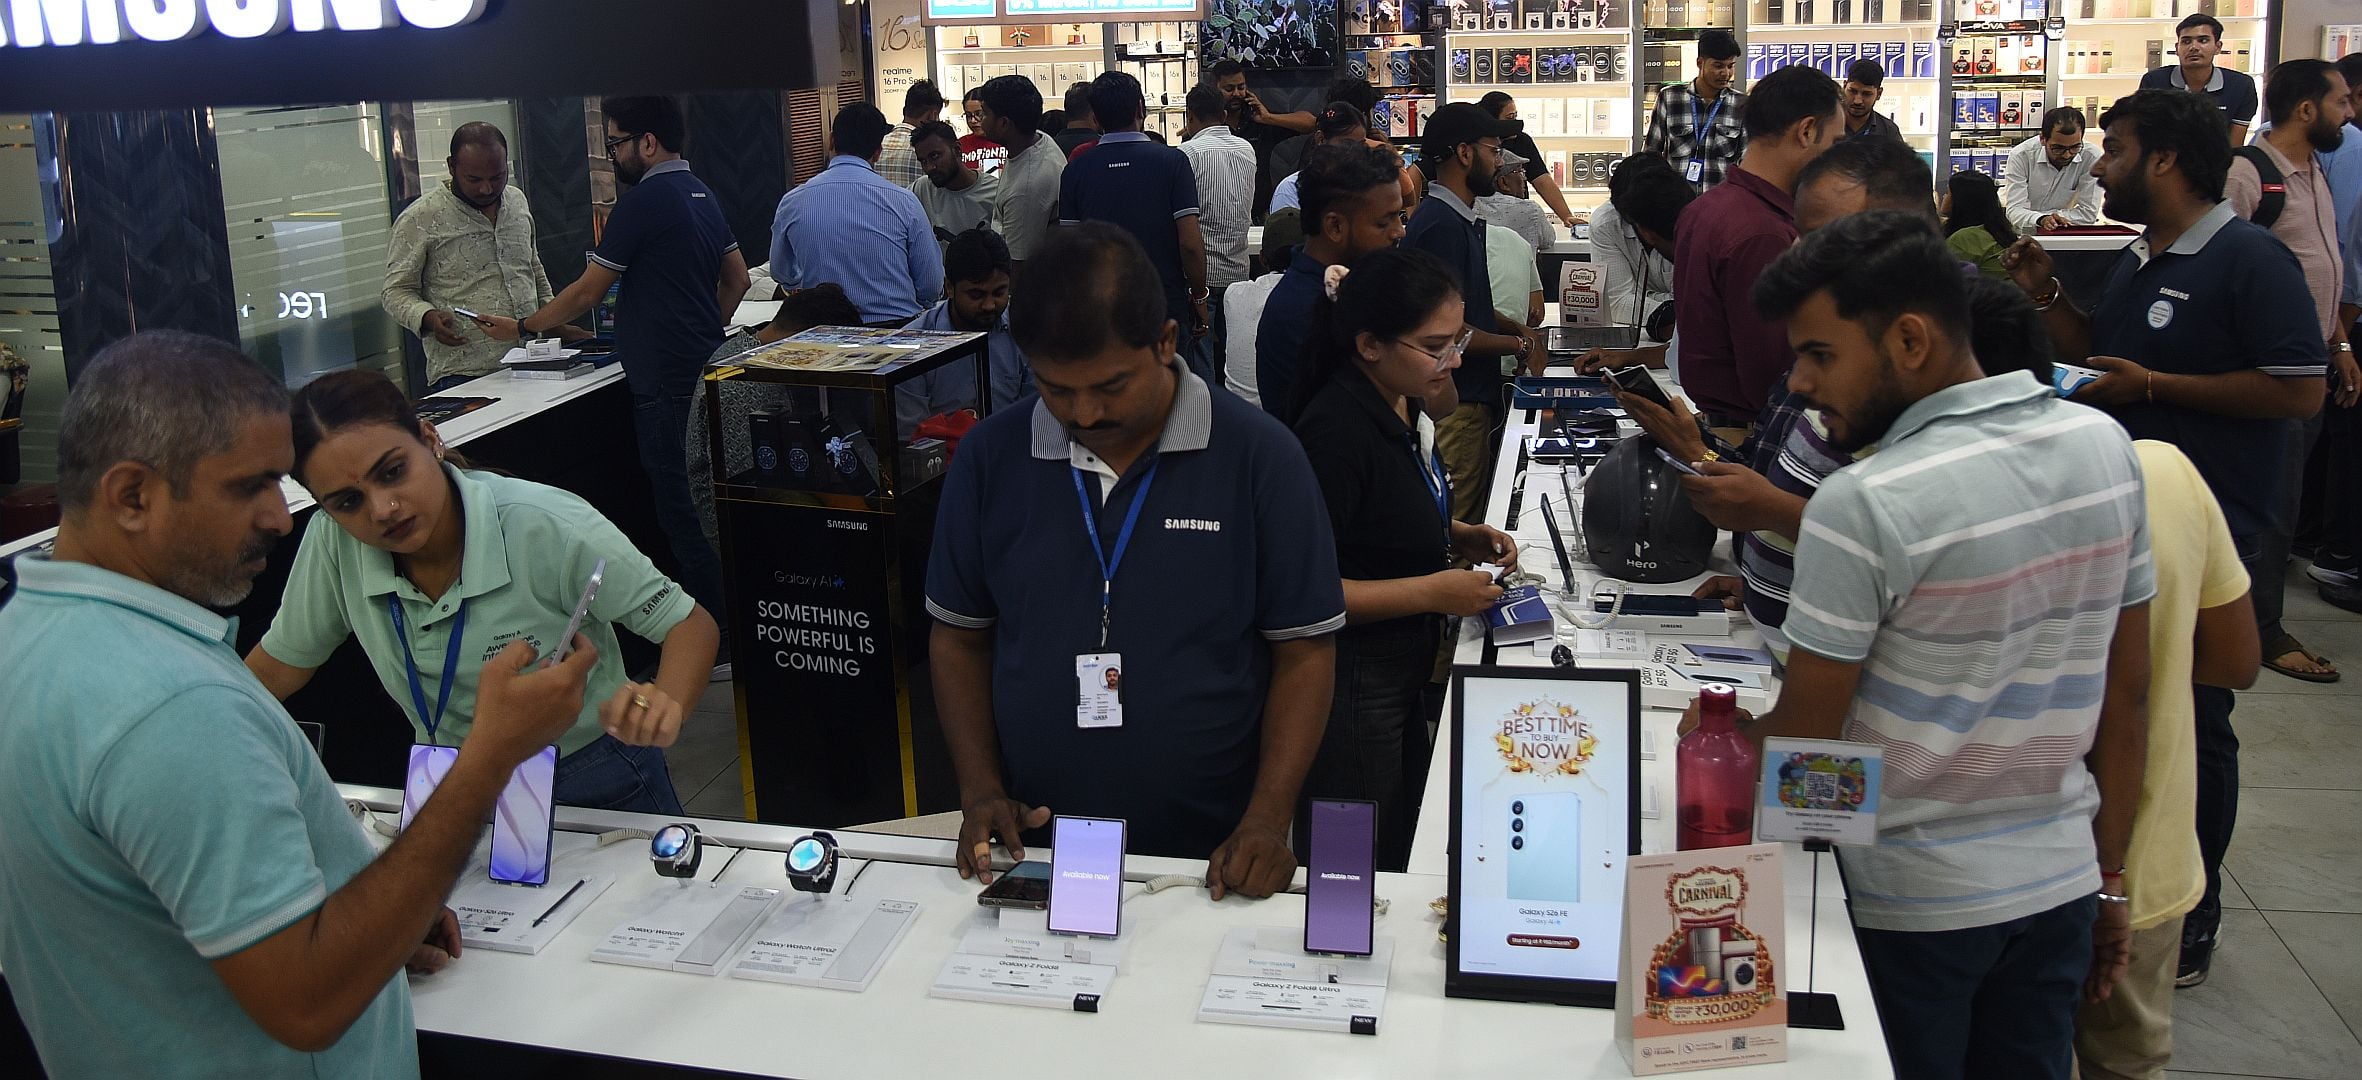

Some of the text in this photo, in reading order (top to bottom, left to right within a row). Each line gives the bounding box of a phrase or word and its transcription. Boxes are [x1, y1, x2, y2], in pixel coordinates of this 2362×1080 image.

[1973, 22, 2005, 30] POVA
[880, 15, 910, 51] 16
[1979, 107, 1994, 122] 5G
[827, 519, 868, 531] SAMSUNG
[1164, 518, 1221, 532] SAMSUNG
[1626, 558, 1658, 569] Hero
[774, 570, 832, 589] Galaxy AI
[758, 600, 870, 629] SOMETHING
[493, 632, 516, 641] Galaxy
[757, 624, 875, 654] POWERFUL IS
[775, 651, 861, 676] COMING
[1503, 717, 1589, 740] BEST TIME
[1530, 733, 1559, 742] TO BUY
[1521, 742, 1571, 759] NOW
[1063, 870, 1093, 879] Available
[1320, 872, 1347, 880] Available
[1678, 883, 1735, 904] CARNIVAL
[1518, 908, 1545, 917] Galaxy
[1525, 917, 1547, 925] Galaxy
[757, 940, 787, 949] Galaxy
[786, 943, 812, 951] Watch
[999, 960, 1028, 969] Galaxy
[1252, 981, 1284, 990] Galaxy
[1078, 994, 1097, 1002] NEW
[1694, 999, 1750, 1017] ₹30,000
[1354, 1016, 1374, 1024] NEW
